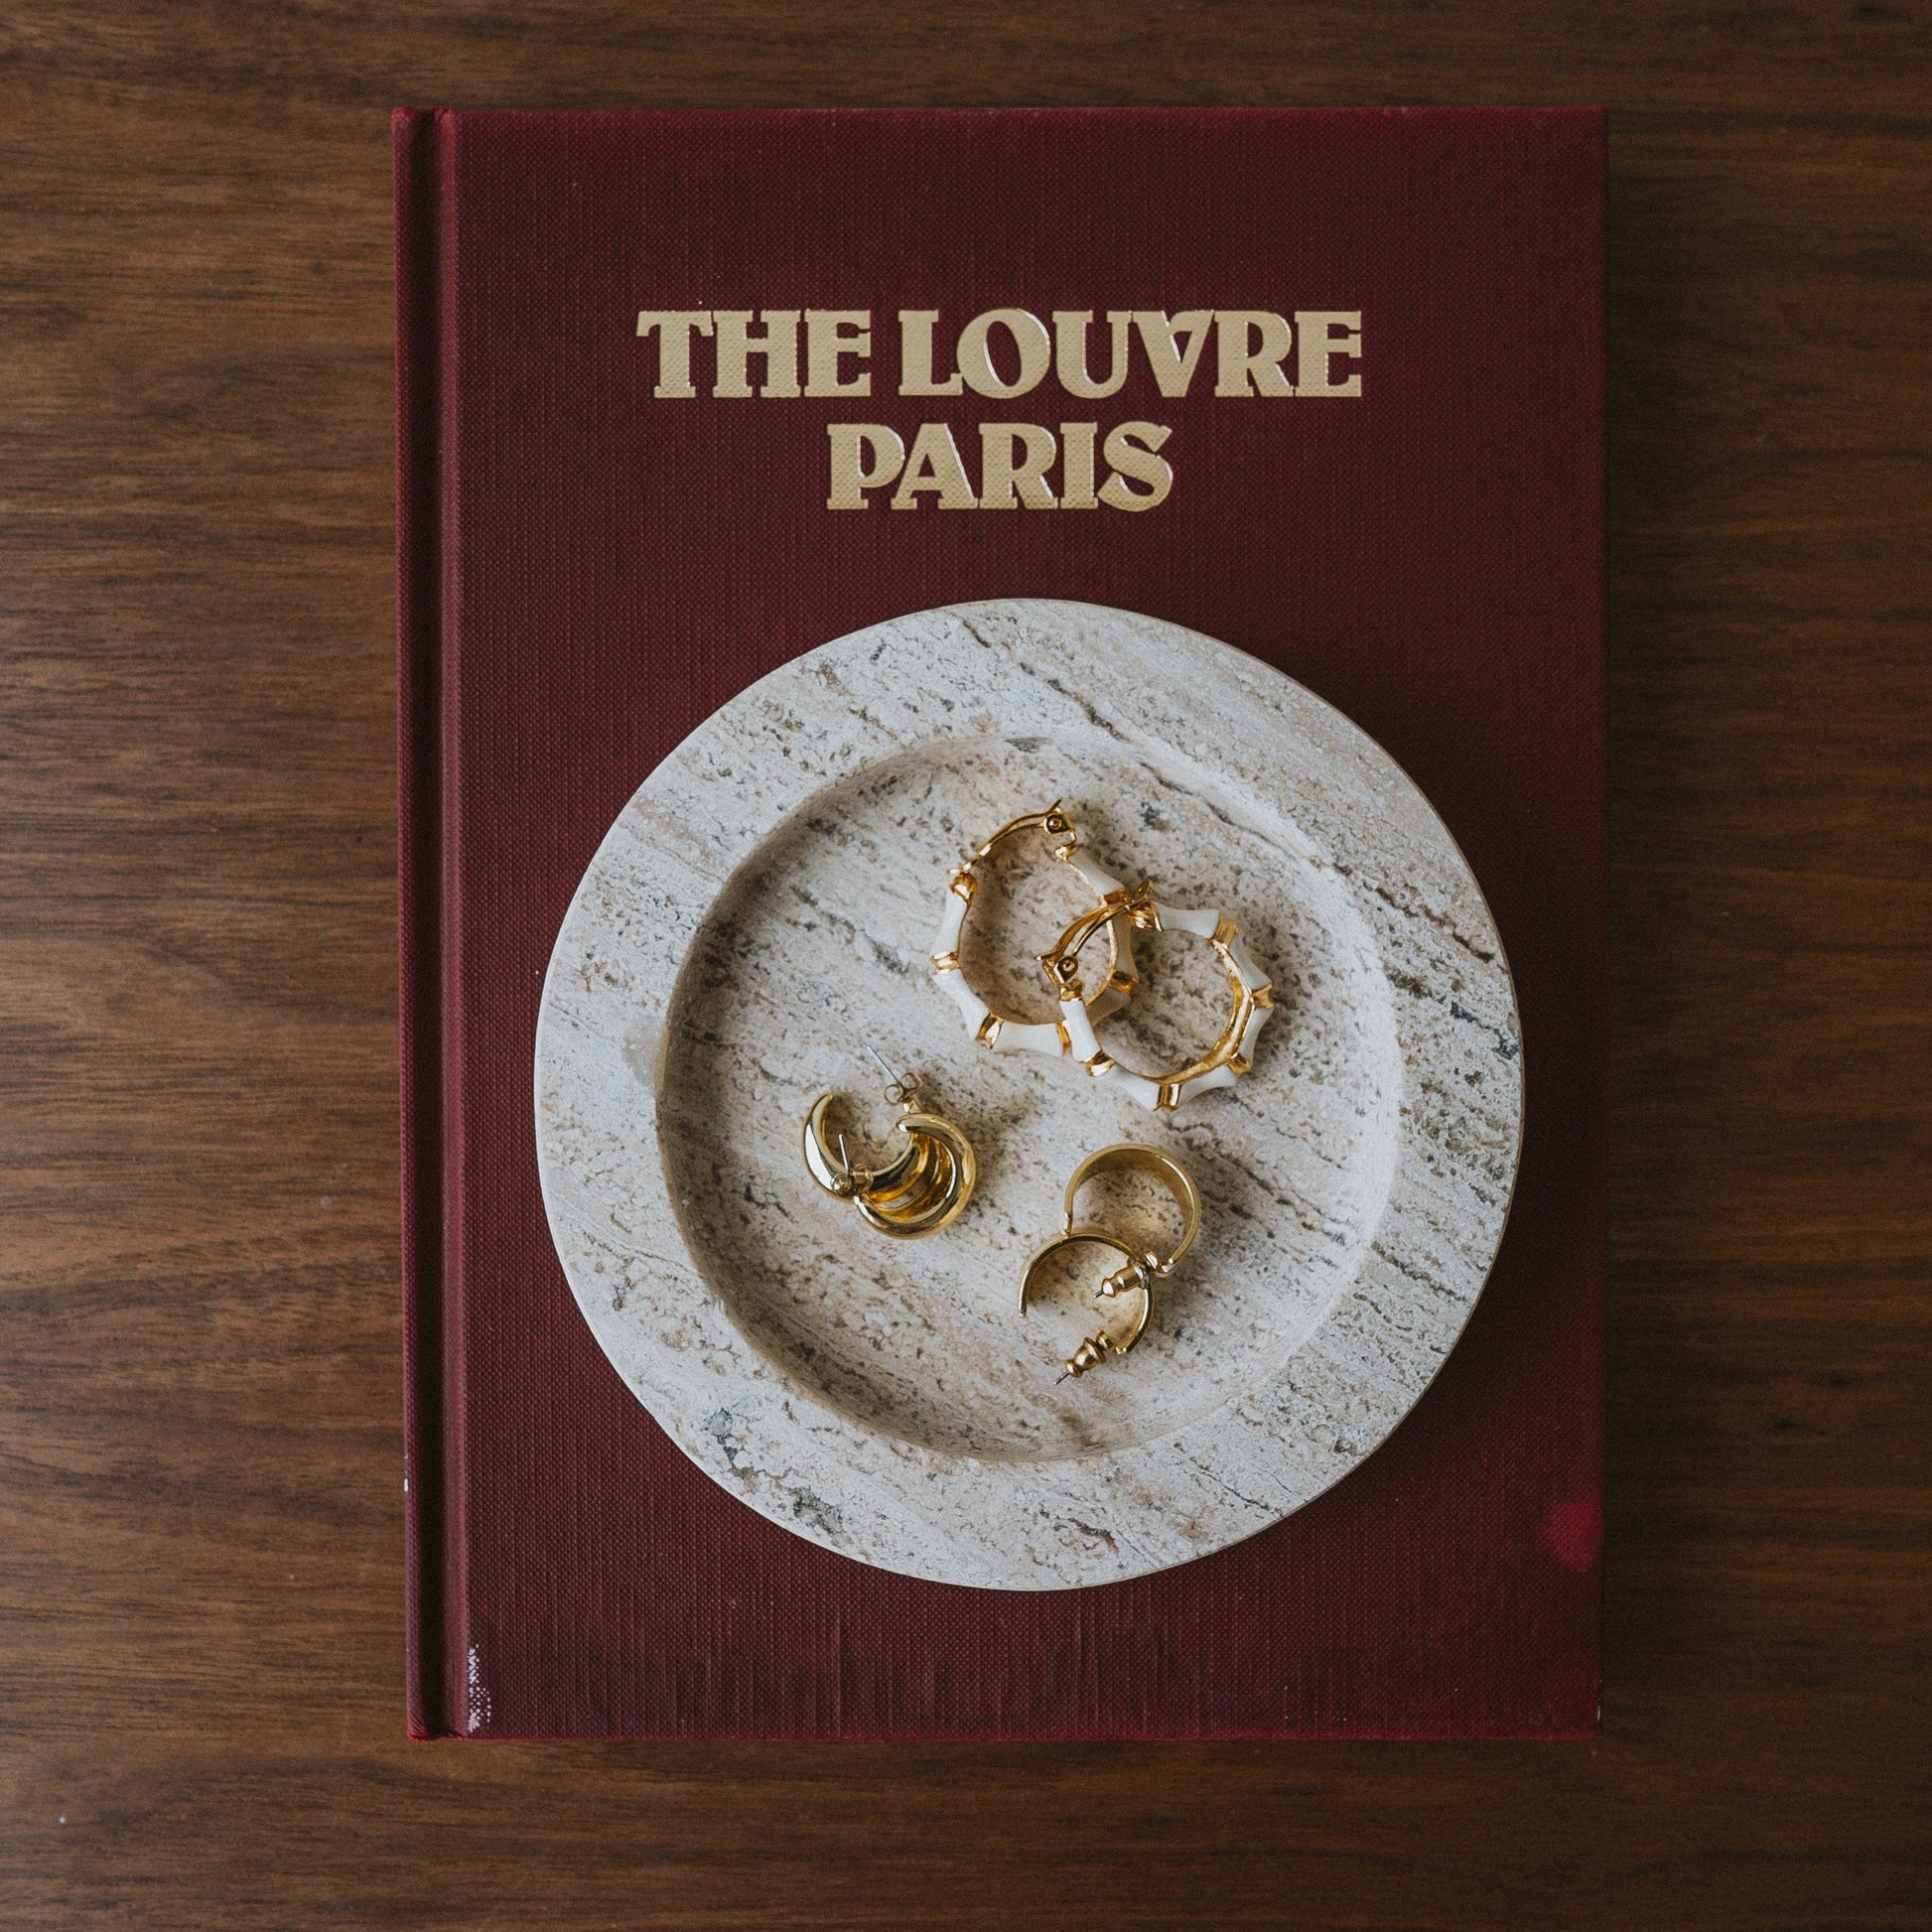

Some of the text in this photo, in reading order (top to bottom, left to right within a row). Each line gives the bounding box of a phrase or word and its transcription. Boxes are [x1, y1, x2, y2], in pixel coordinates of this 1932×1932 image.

[636, 308, 1363, 400] THE LOUVRE
[826, 422, 1175, 512] PARIS
